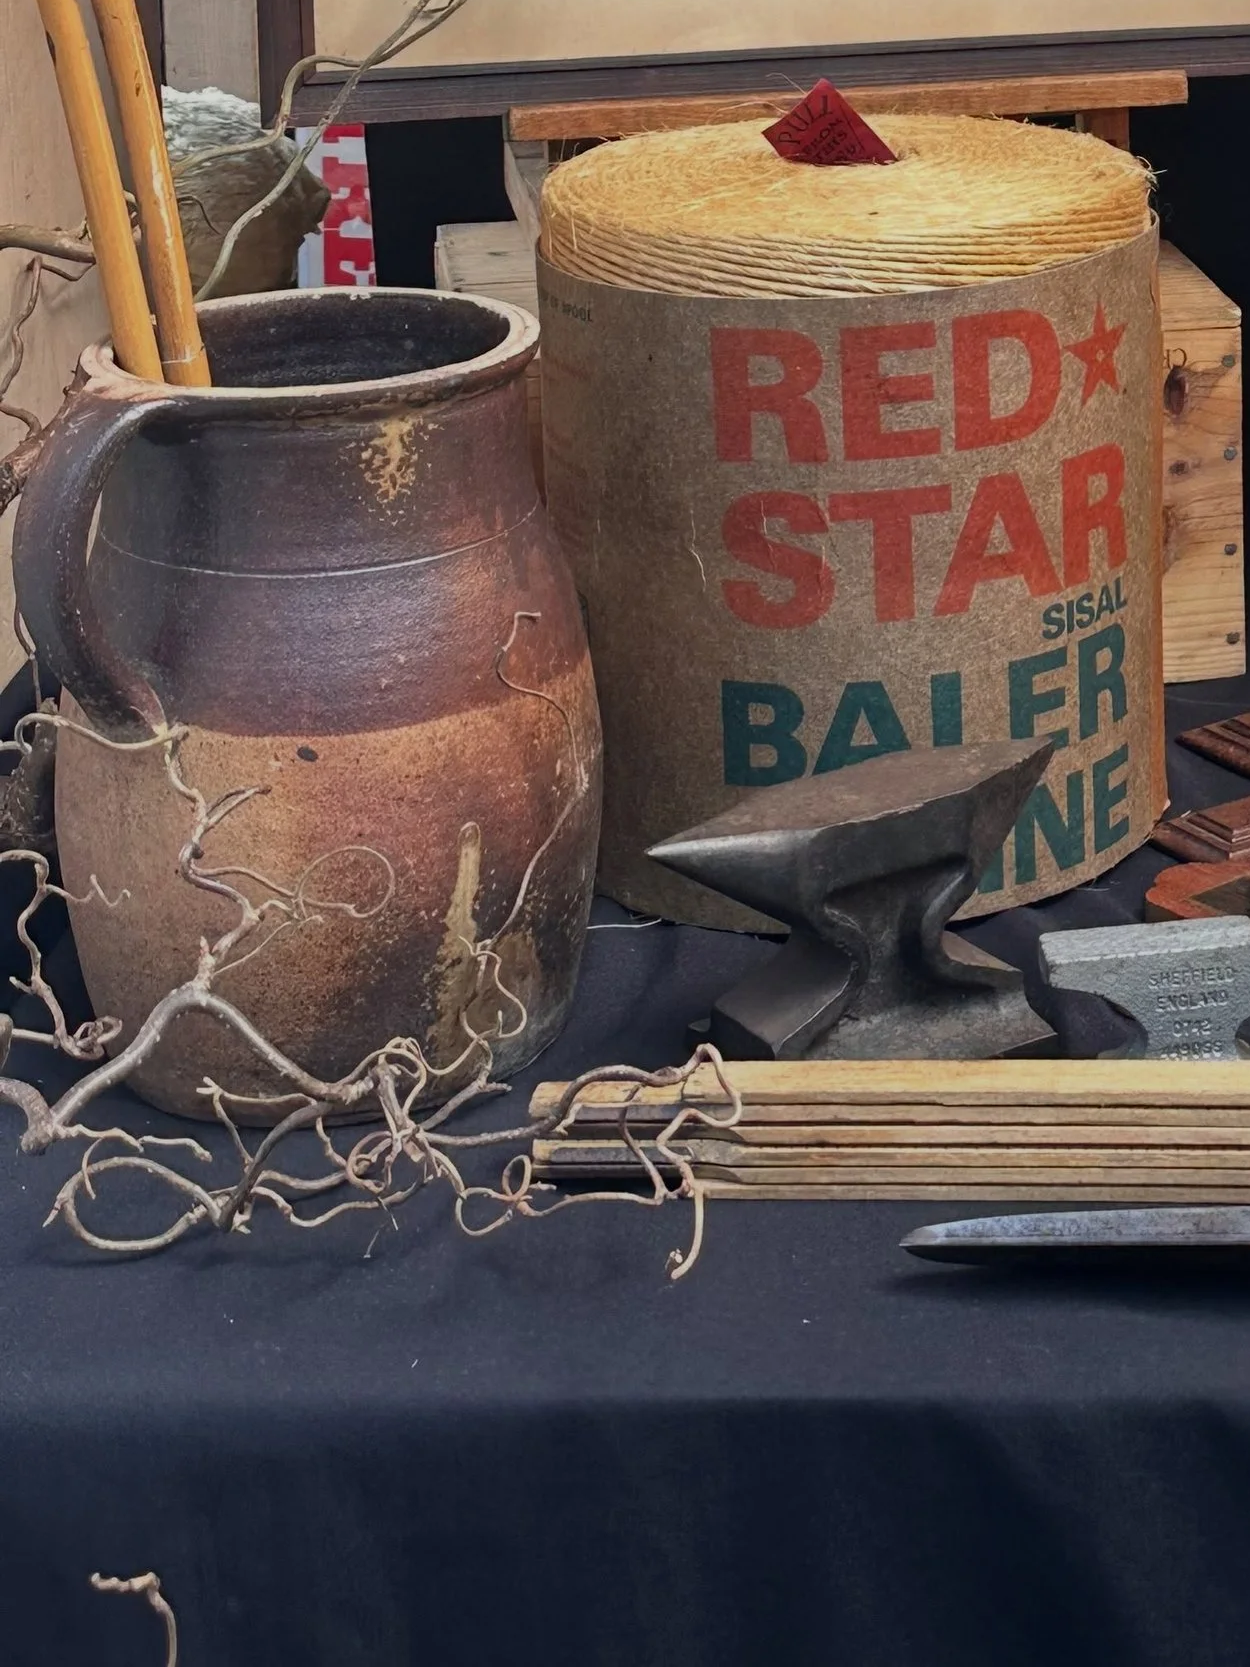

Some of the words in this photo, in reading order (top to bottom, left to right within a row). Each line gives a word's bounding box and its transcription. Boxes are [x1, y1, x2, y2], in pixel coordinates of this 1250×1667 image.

[709, 309, 1061, 463] RED
[719, 443, 1127, 629] STAR
[1042, 577, 1128, 640] SISAL
[1148, 966, 1236, 990] SHEFFIELD
[1155, 989, 1230, 1013] ENGLAND
